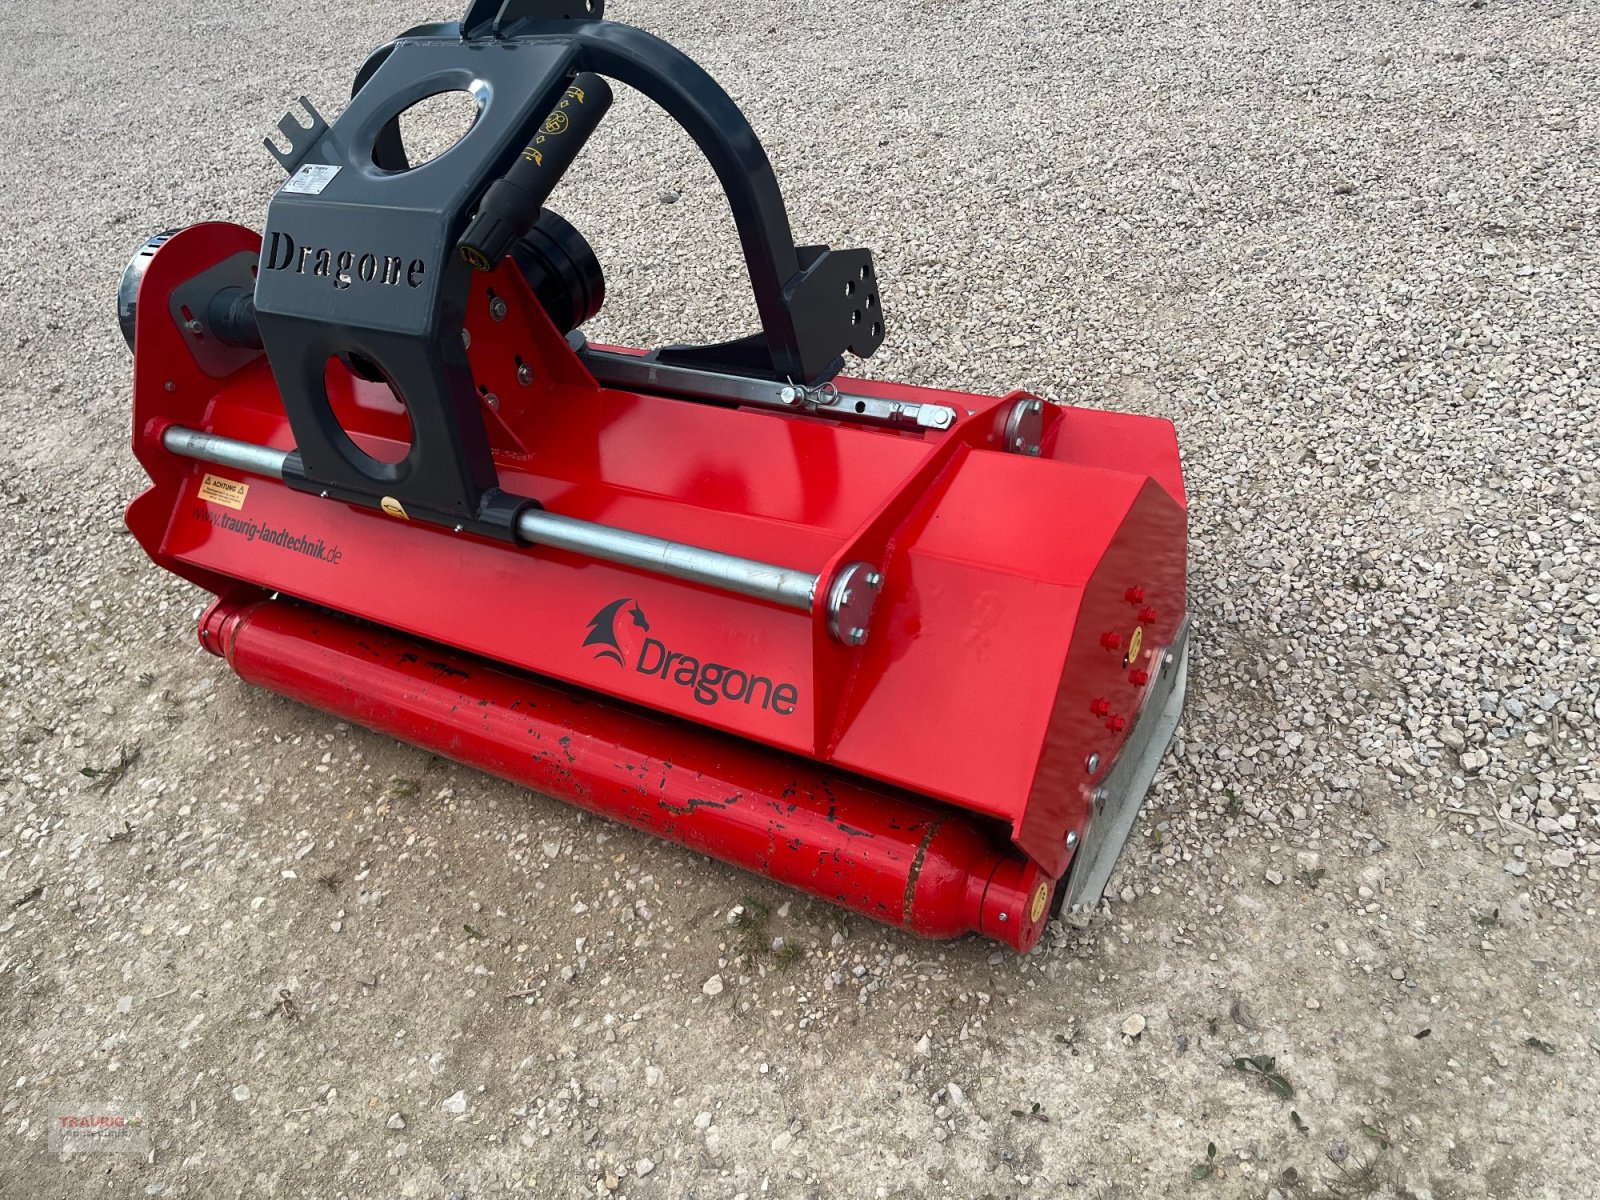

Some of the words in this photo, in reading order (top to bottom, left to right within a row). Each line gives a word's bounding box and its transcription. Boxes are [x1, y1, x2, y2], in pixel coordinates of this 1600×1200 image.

[266, 231, 426, 290] Dragone
[212, 480, 237, 492] ACHTUNG
[192, 505, 342, 565] www.traurig-landtechnik.de
[636, 637, 798, 715] Dragone
